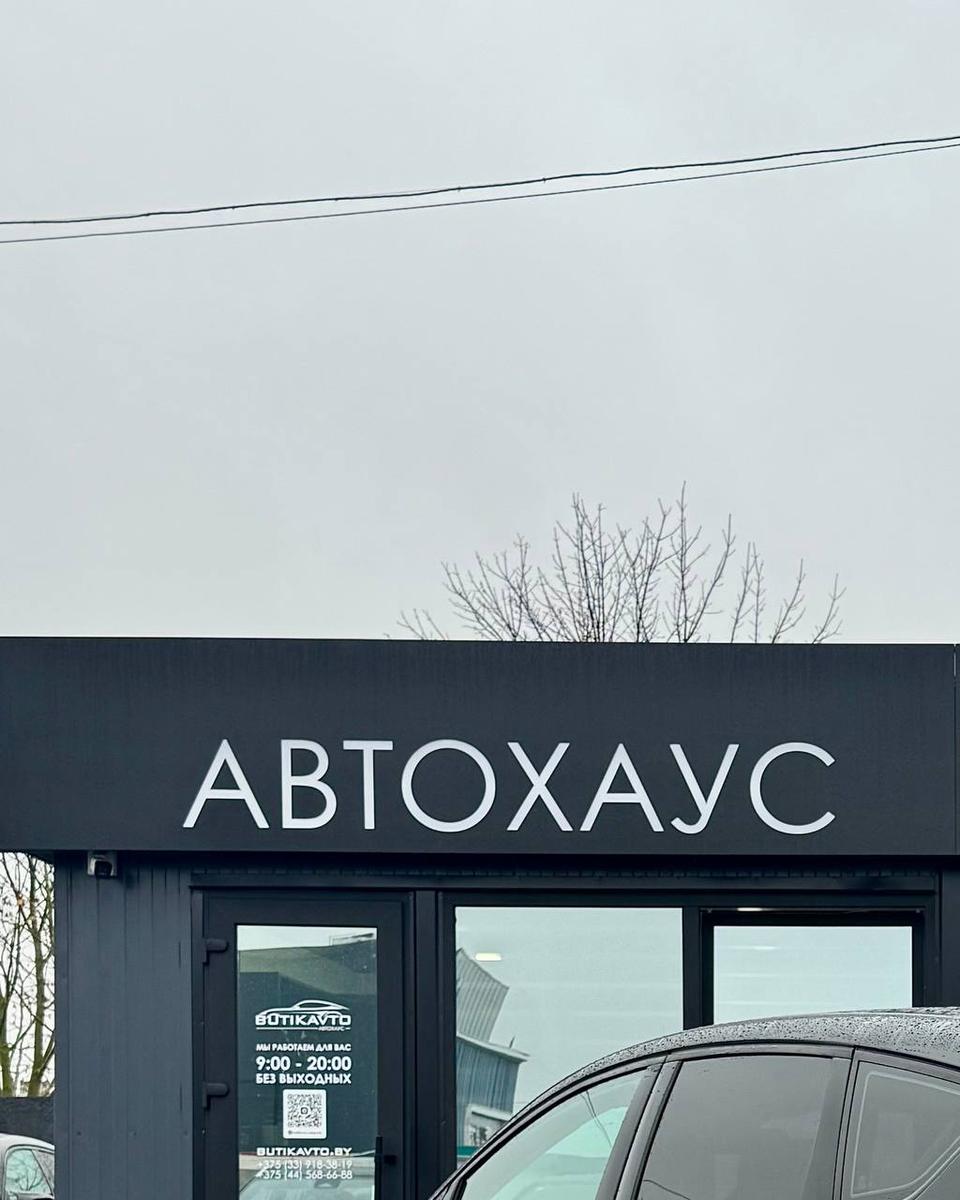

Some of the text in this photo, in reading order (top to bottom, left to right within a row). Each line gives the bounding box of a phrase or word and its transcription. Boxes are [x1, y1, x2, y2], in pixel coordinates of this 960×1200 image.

[182, 739, 836, 835] АВТОХАУС
[255, 1014, 352, 1026] BUTIKAVTO
[256, 1043, 352, 1052] МЫ РАБОТАЕМ ДЛЯ ВАС
[255, 1056, 291, 1071] 9:00
[306, 1056, 352, 1071] 20:00
[255, 1073, 352, 1085] БЕЗ ВЫХОДНЫХ
[256, 1147, 353, 1156] BUTIKAVTO.BY
[284, 1160, 303, 1172] (33)
[284, 1170, 303, 1181] (44)
[305, 1170, 353, 1180] 568-66-88
